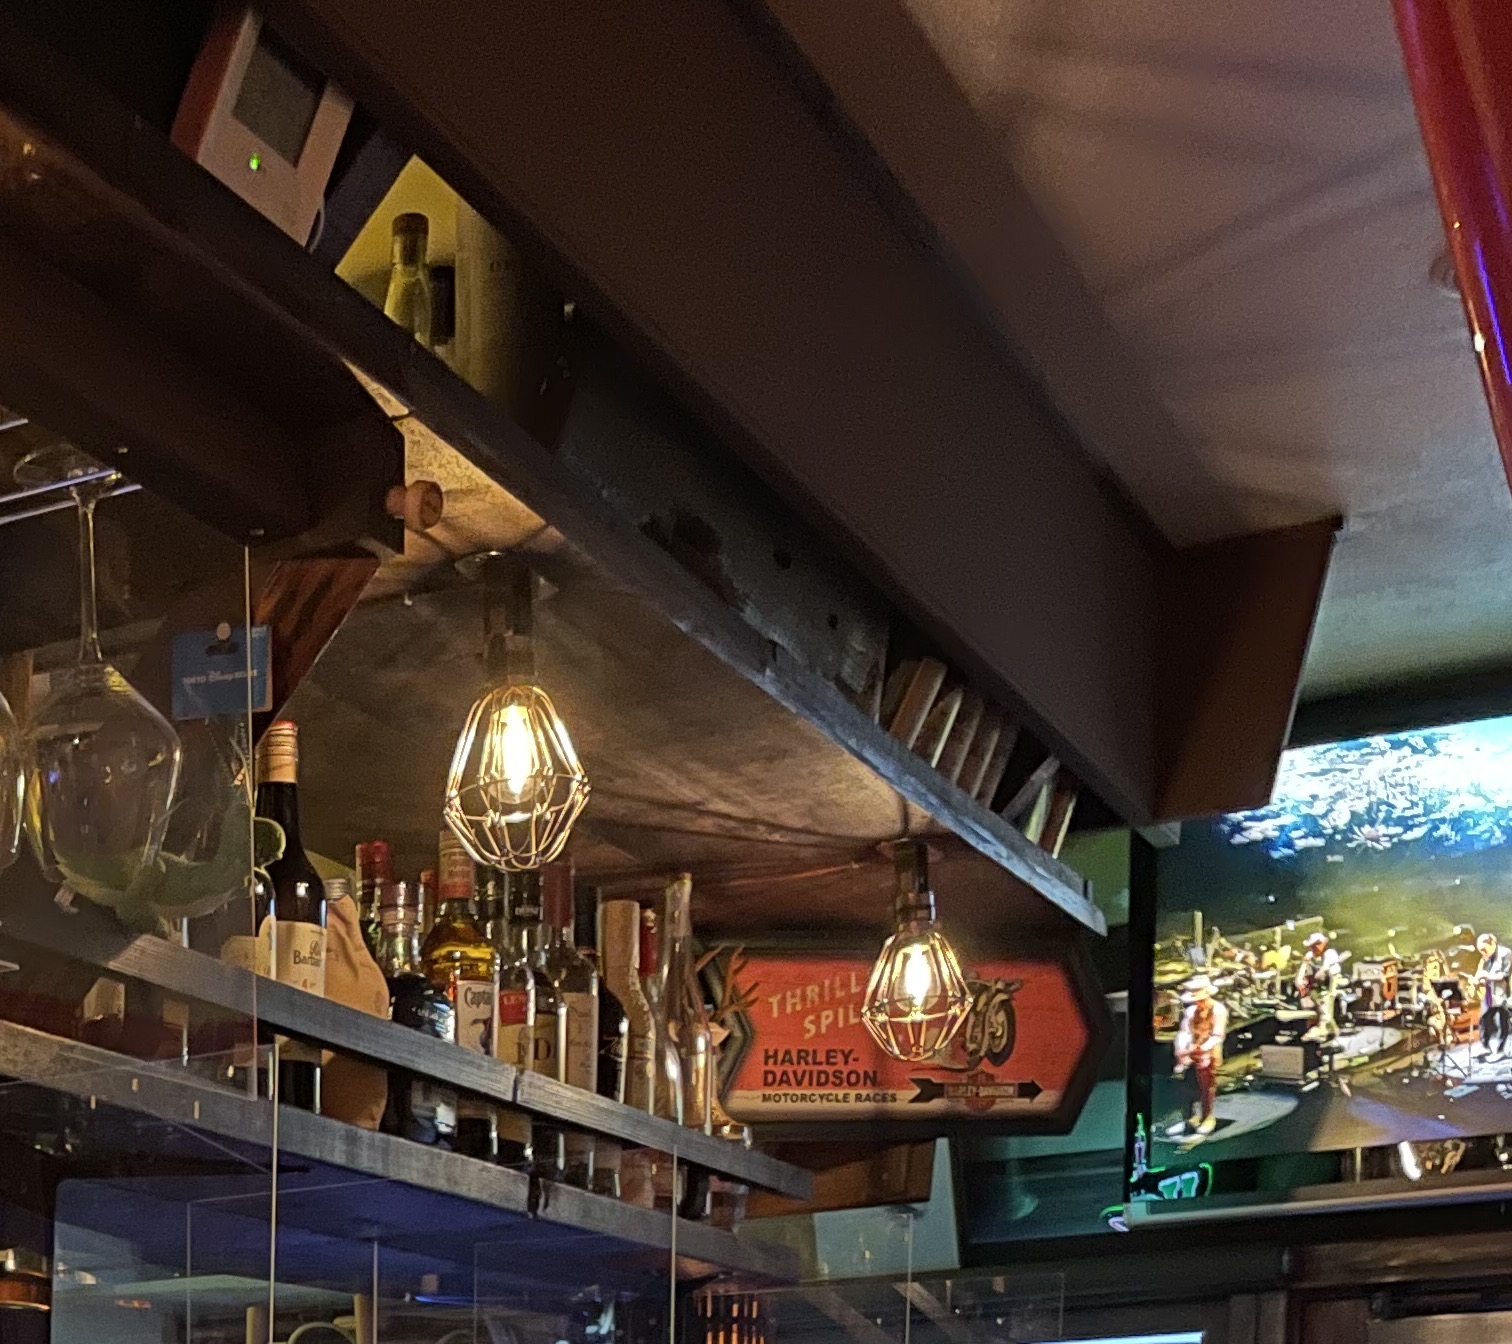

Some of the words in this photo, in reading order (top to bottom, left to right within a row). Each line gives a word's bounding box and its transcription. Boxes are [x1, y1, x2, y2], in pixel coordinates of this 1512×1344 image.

[762, 1048, 860, 1067] HARLEY-
[762, 1069, 879, 1088] DAVIDSON
[761, 1091, 848, 1104] MOTORCYCLE
[854, 1092, 898, 1104] RACES
